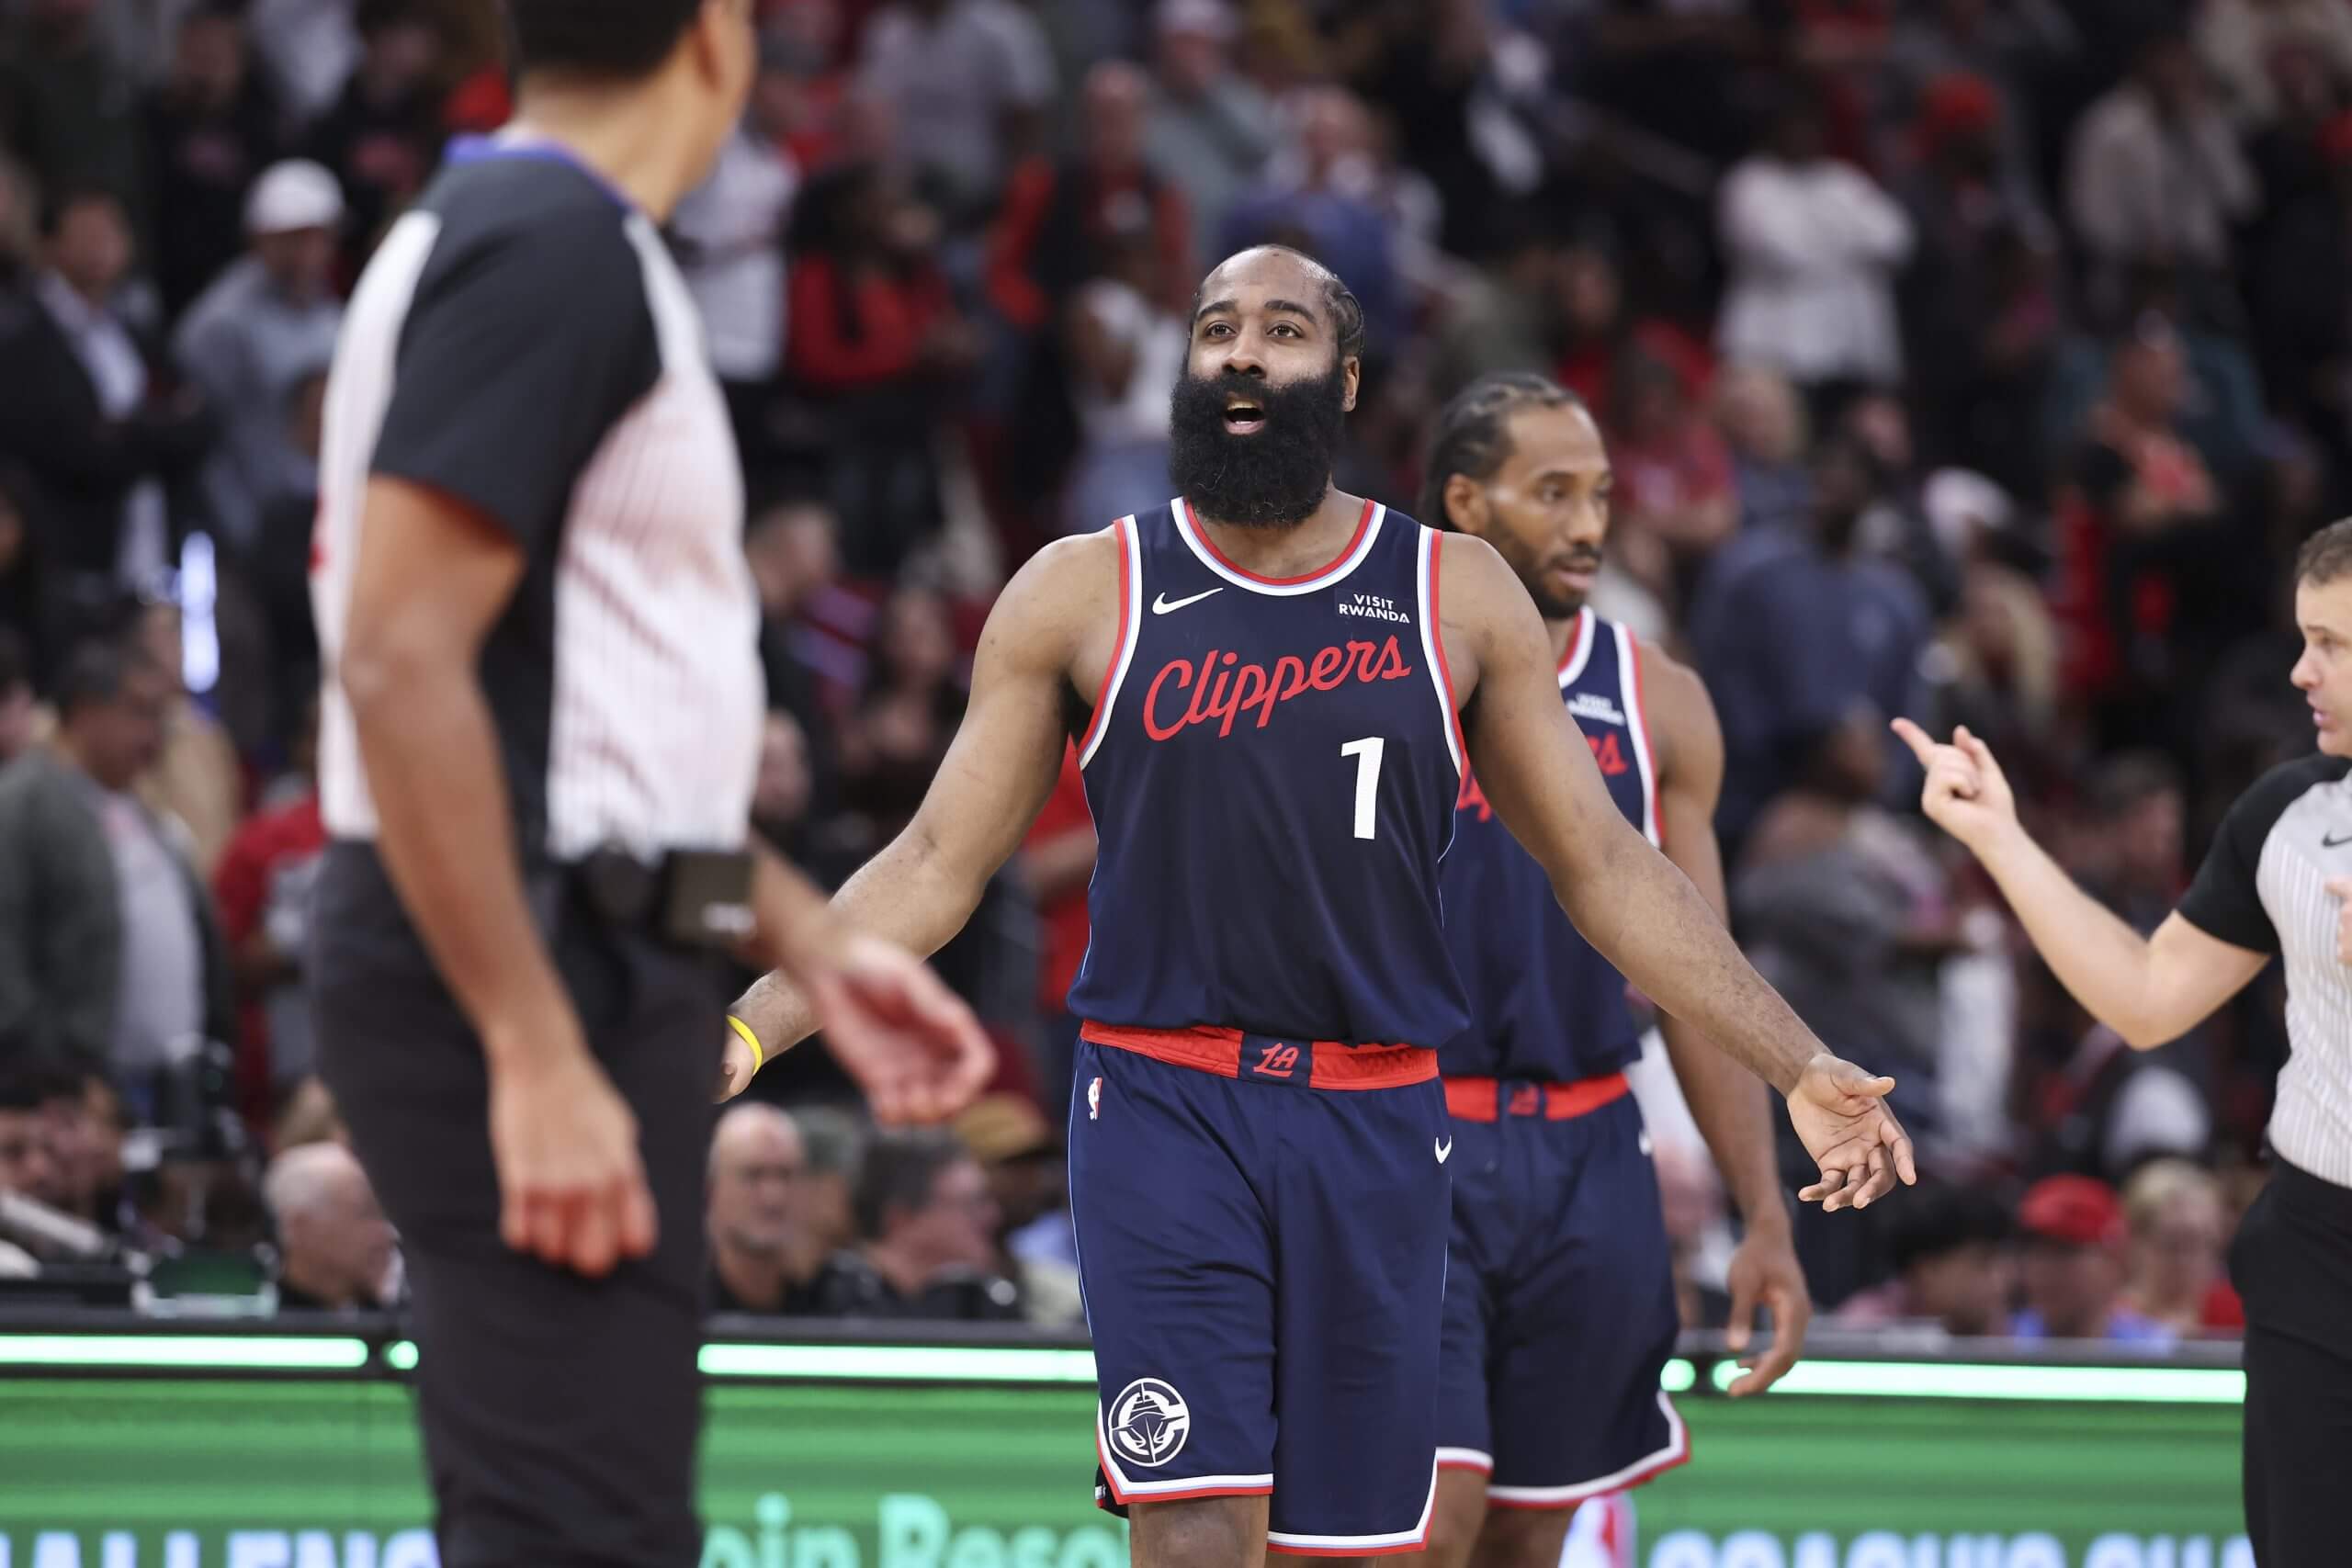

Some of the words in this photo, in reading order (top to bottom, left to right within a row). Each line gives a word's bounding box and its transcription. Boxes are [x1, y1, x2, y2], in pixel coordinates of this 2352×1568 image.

[1339, 604, 1410, 624] RWANDA
[1353, 593, 1394, 610] VISIT
[1143, 635, 1412, 740] Clippers
[1340, 737, 1385, 839] 1
